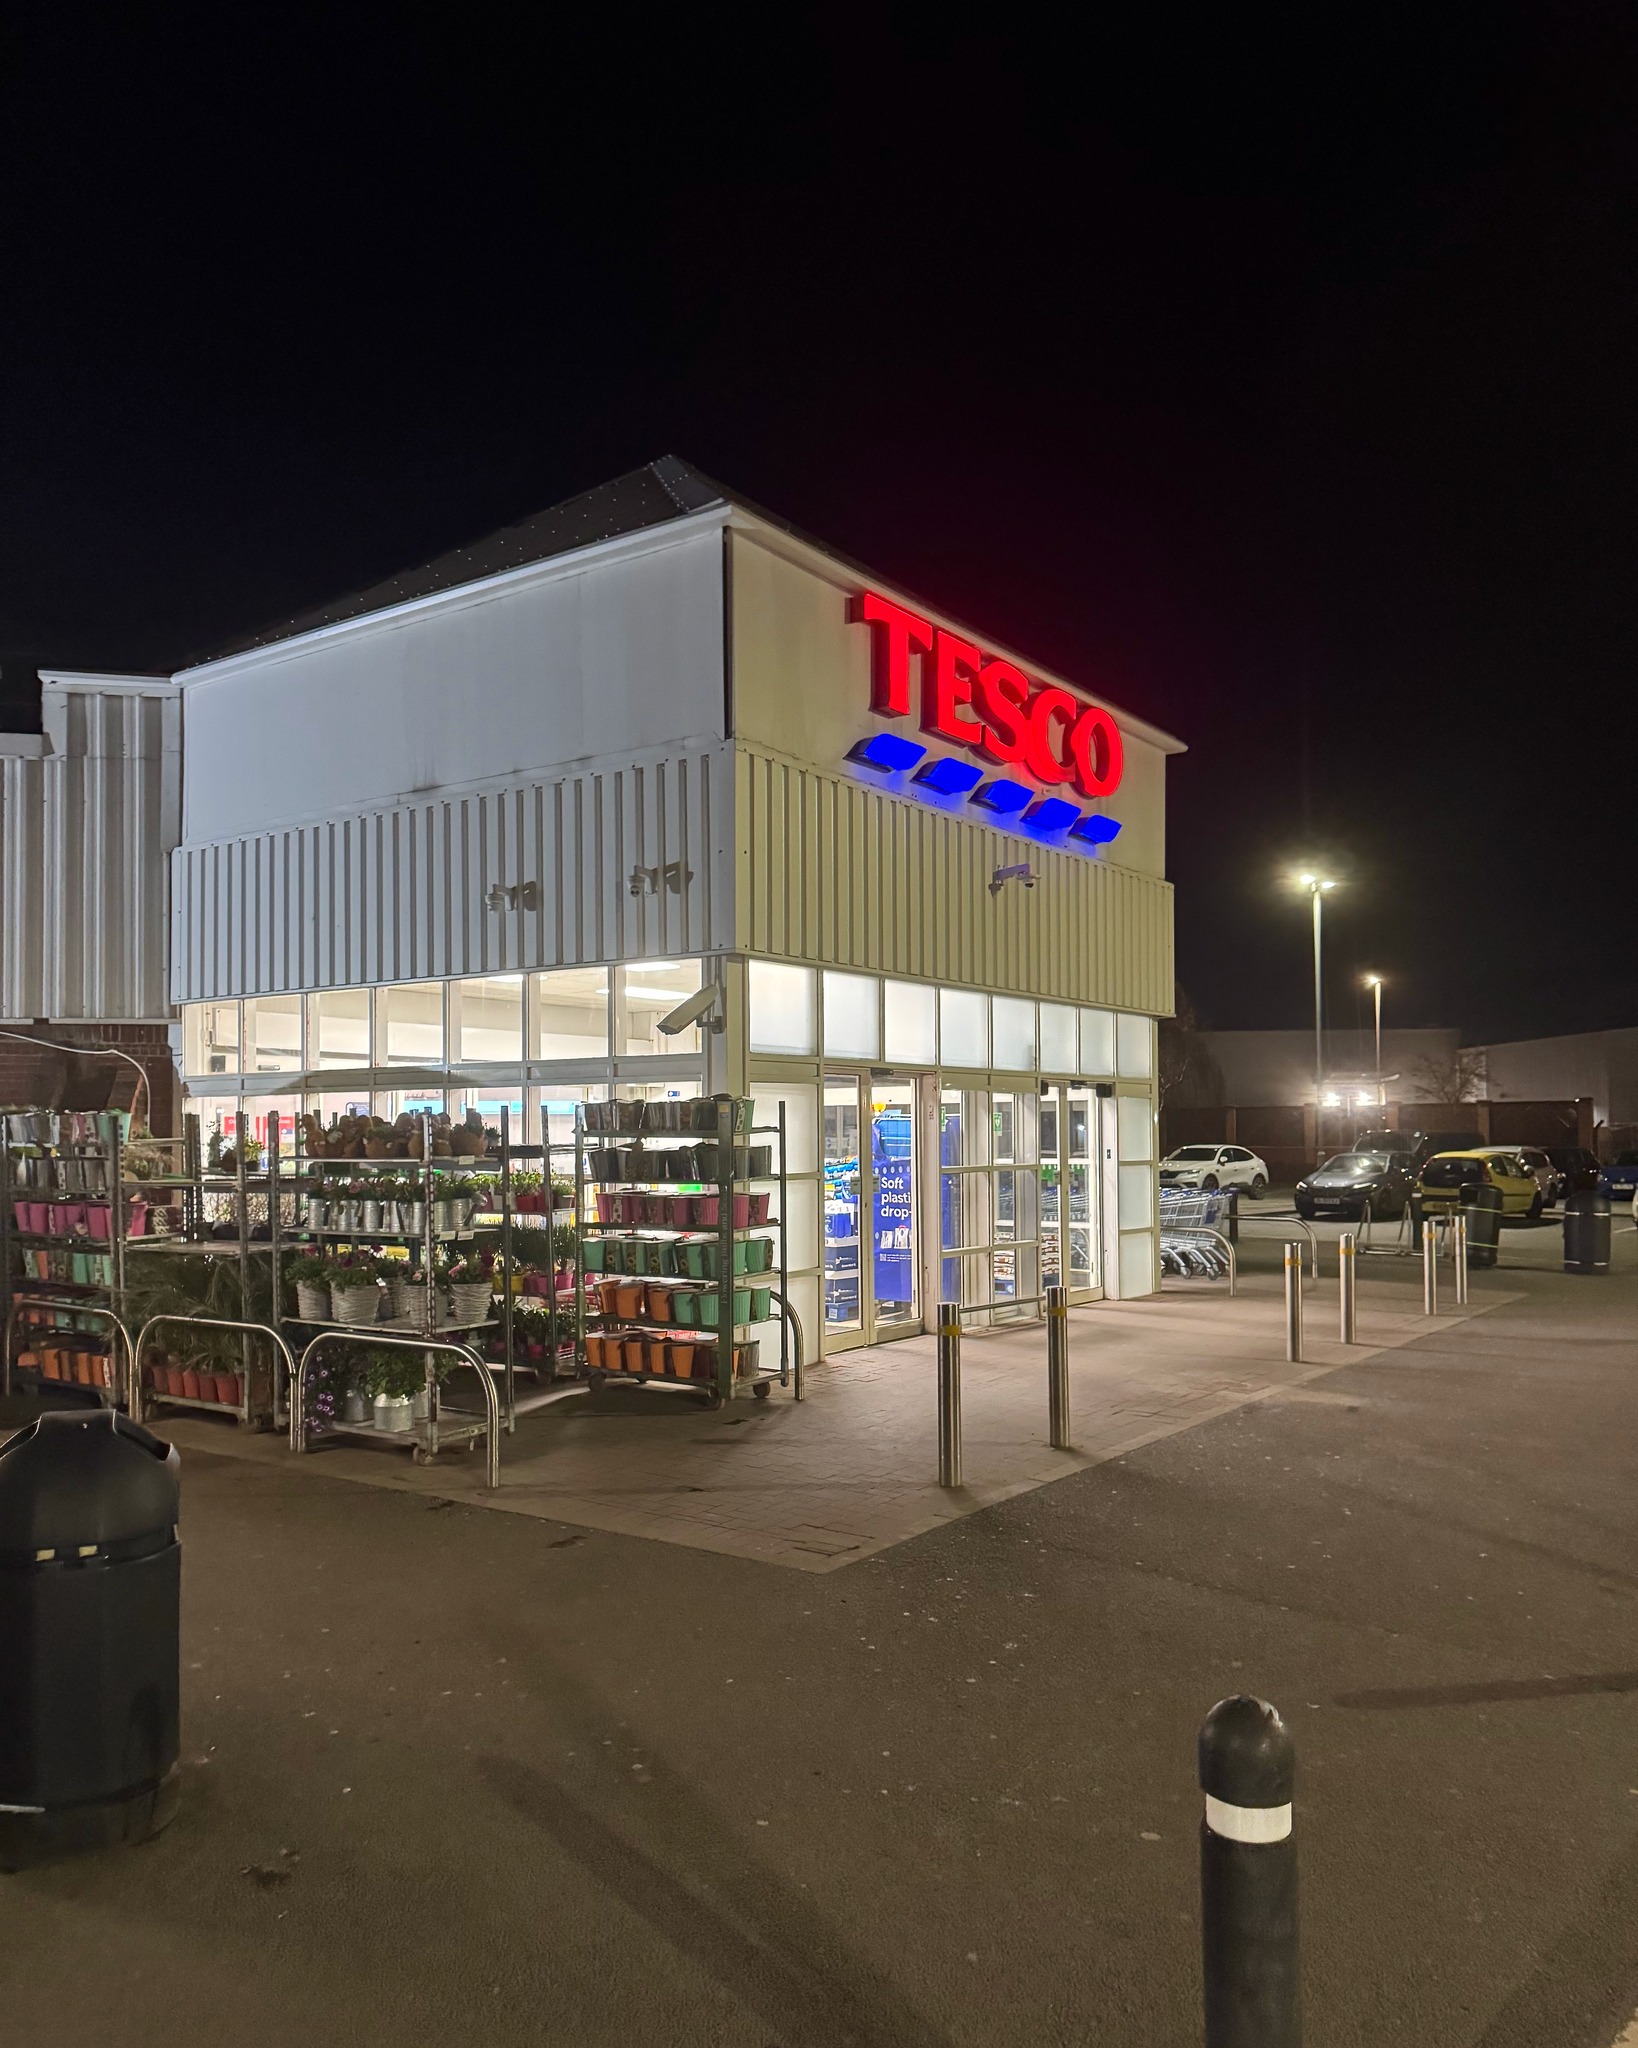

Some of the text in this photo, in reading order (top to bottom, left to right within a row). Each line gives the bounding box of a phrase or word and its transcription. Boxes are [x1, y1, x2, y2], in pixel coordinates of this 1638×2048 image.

[862, 593, 1124, 797] TESCO
[881, 1176, 904, 1190] Soft
[881, 1191, 911, 1206] plasti
[720, 1213, 728, 1231] and
[720, 1233, 728, 1257] Bulbs
[720, 1259, 729, 1304] Flowering
